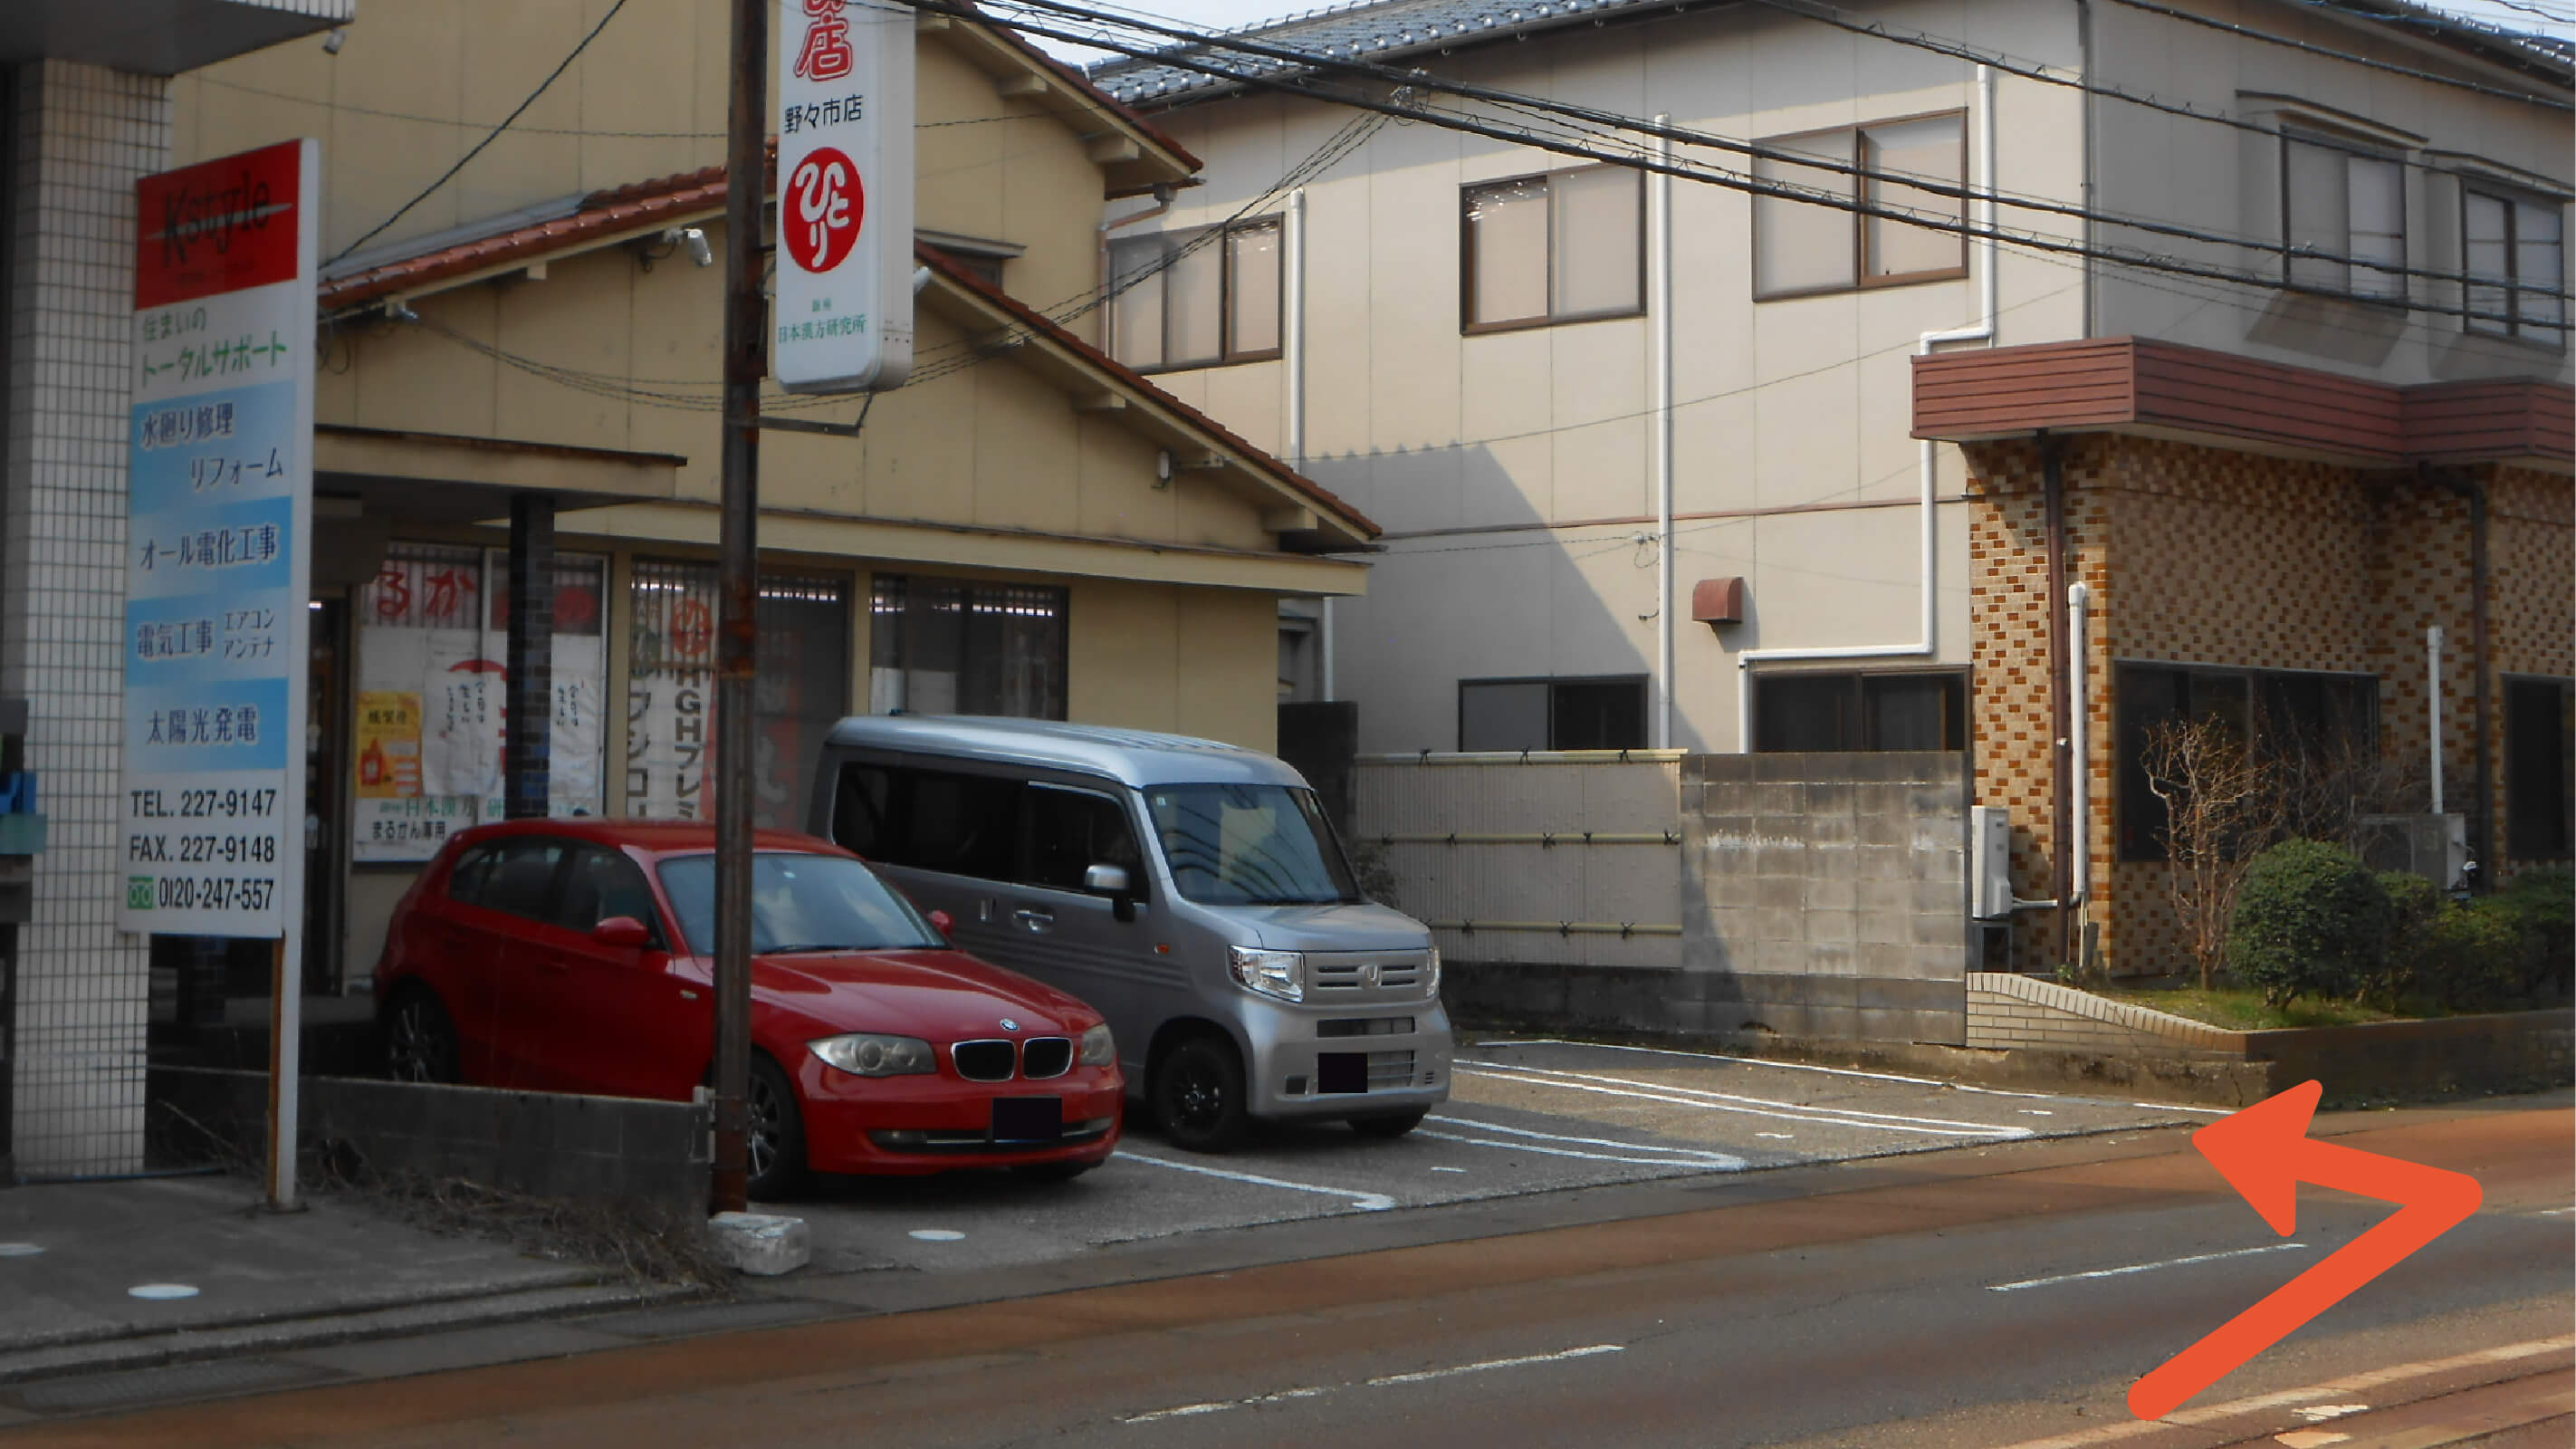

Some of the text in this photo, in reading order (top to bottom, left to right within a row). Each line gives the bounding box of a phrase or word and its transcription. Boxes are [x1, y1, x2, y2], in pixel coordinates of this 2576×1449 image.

[784, 93, 864, 134] 野々市店
[795, 162, 851, 269] ひとり
[143, 307, 206, 342] 住まいの
[142, 330, 287, 389] トータルサポート
[141, 402, 235, 448] 水廻り修理
[191, 446, 283, 489] リフォーム
[139, 523, 277, 571] オール電化工事
[137, 619, 214, 658] 電気工事
[225, 609, 275, 632] エアコン
[224, 636, 275, 659] アンテナ
[146, 706, 257, 745] 太陽光発電
[130, 789, 276, 818] TEL. 227-9147
[129, 835, 275, 862] FAX. 227-9148
[158, 877, 274, 910] 0120-247-557
